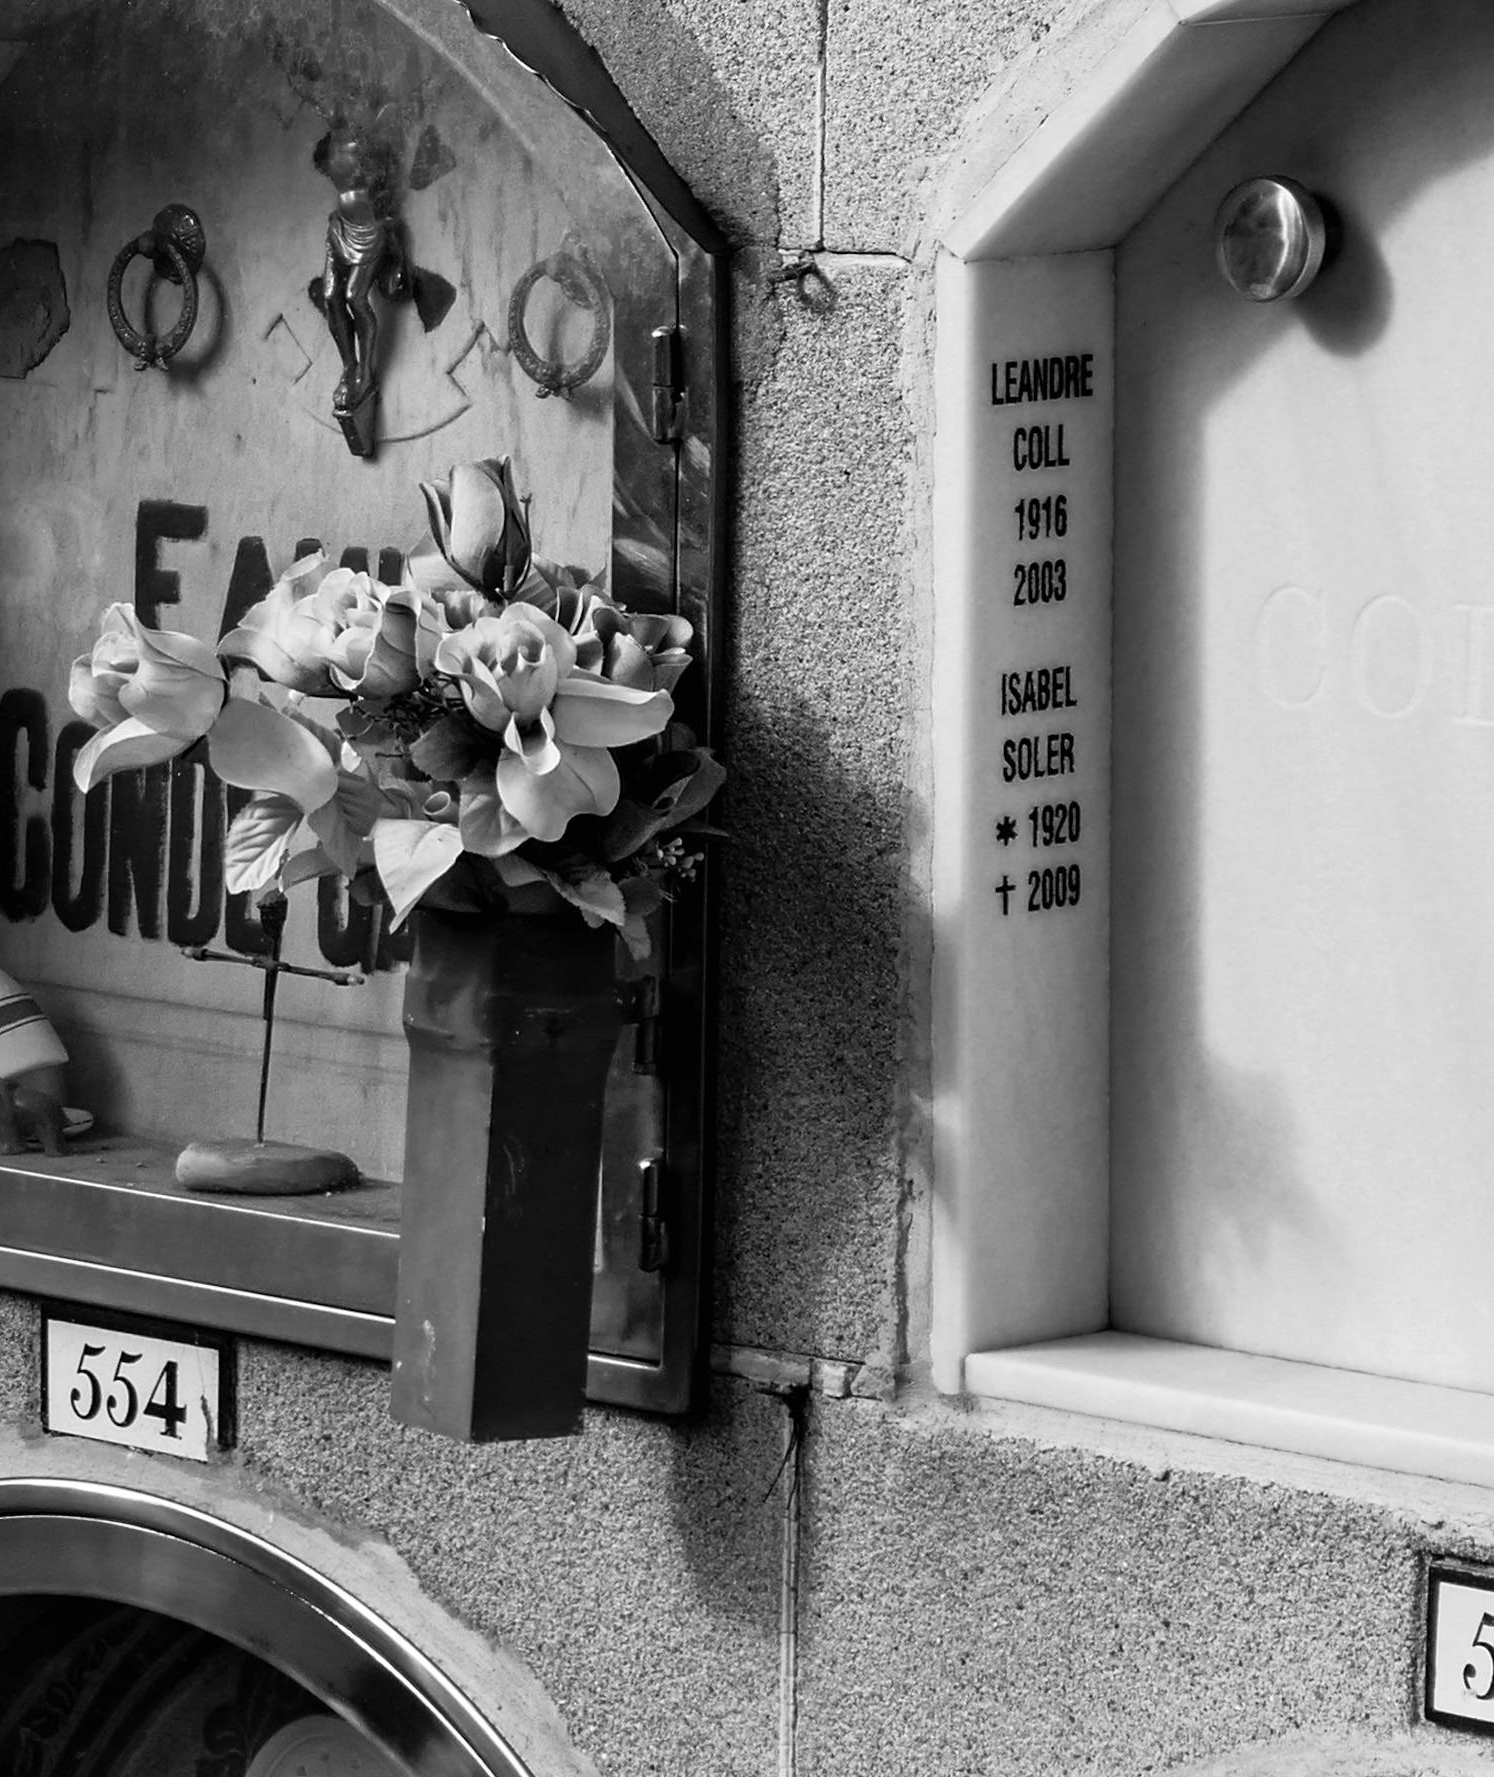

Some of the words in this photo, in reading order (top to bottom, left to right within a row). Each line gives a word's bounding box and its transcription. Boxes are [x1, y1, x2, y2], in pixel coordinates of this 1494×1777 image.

[991, 354, 1095, 405] LEANDRE
[1013, 424, 1070, 470] COLL
[1015, 496, 1069, 540] 1916
[1013, 560, 1068, 606] 2003
[1001, 667, 1078, 716] ISABEL
[1002, 733, 1076, 782] SOLER
[1028, 801, 1082, 847] 1920
[1027, 864, 1082, 912] 2009
[70, 1343, 189, 1439] 554
